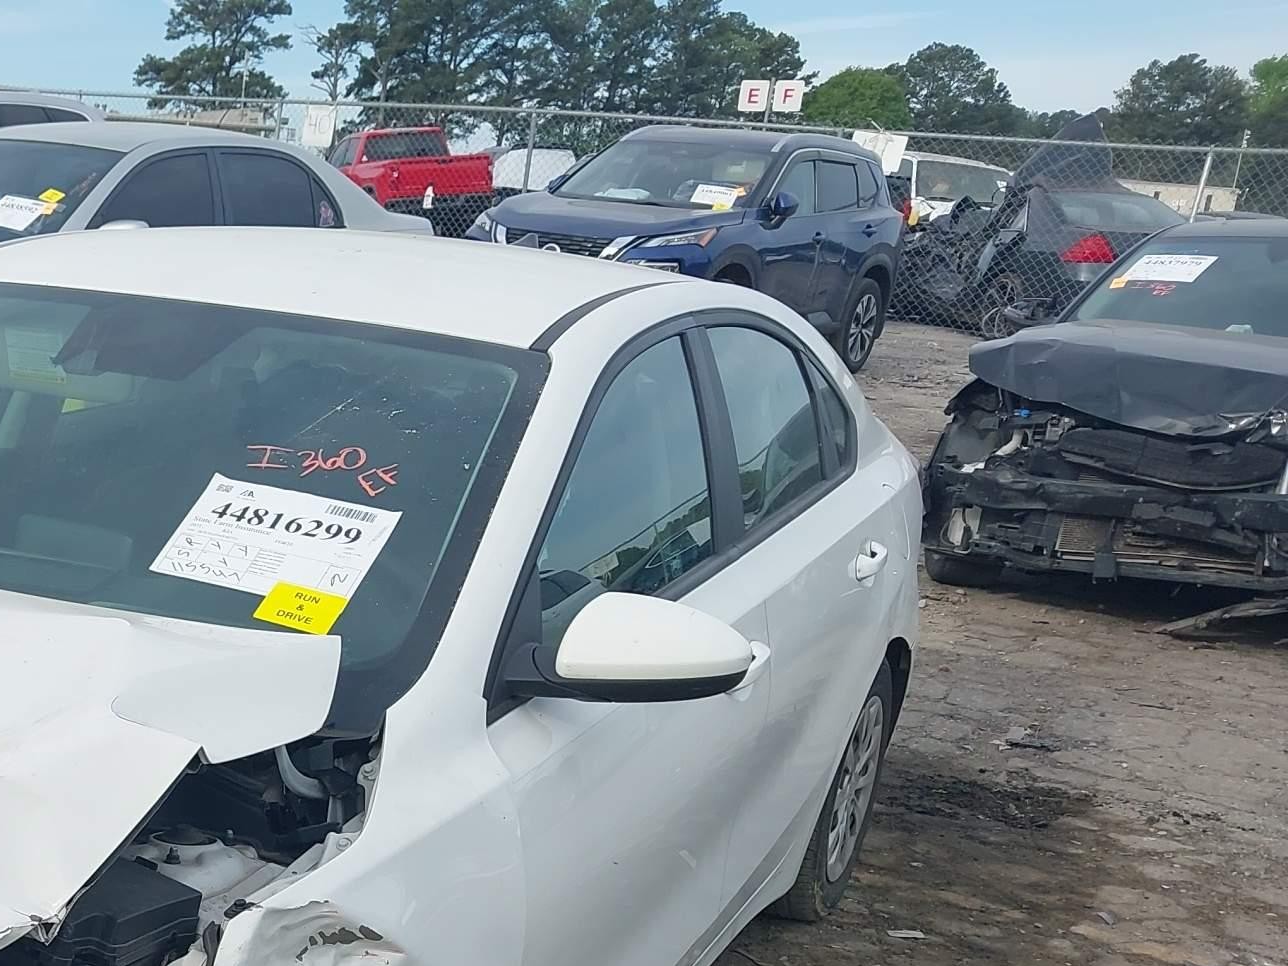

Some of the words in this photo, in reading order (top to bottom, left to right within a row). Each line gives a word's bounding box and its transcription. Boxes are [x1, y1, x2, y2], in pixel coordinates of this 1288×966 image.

[747, 88, 760, 104] E
[782, 88, 795, 104] F
[212, 502, 362, 545] 44816299
[294, 592, 320, 604] RUN
[276, 610, 313, 625] DRIVE
